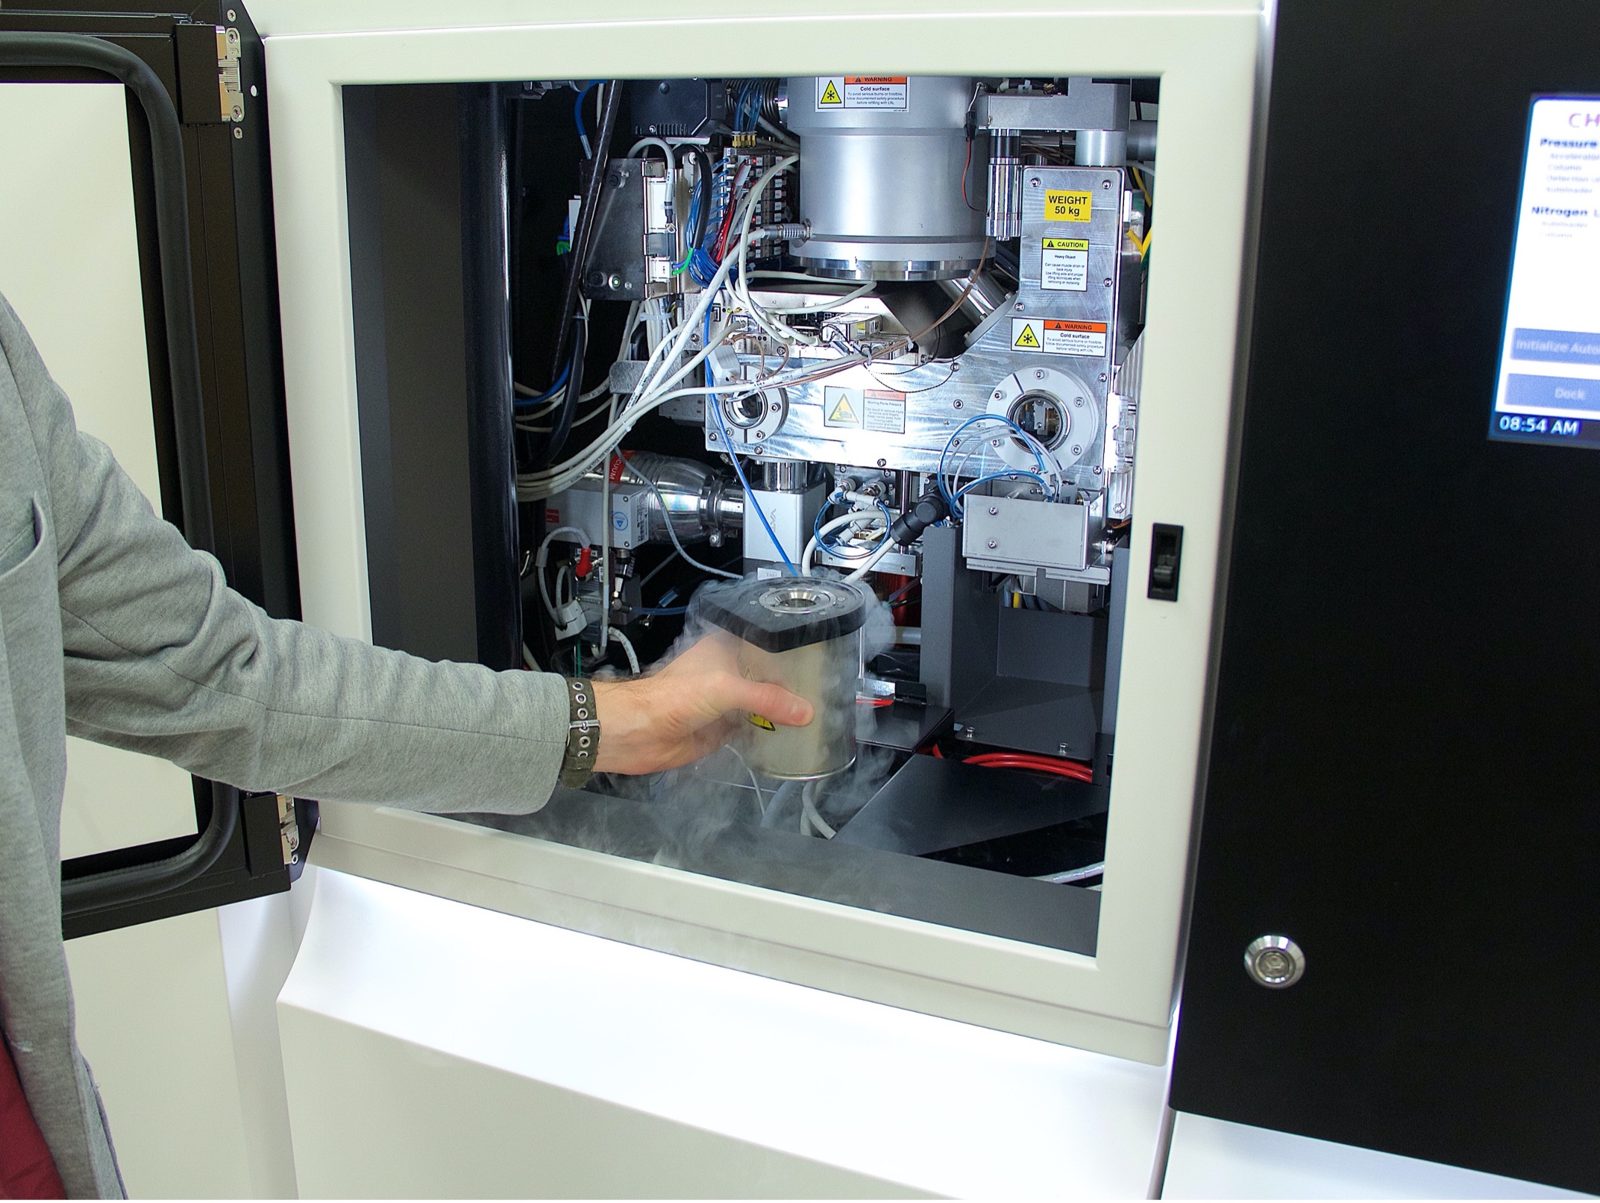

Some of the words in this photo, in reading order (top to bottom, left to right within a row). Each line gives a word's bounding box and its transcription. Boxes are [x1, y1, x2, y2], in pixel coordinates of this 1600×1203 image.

[1540, 138, 1598, 147] Pressure
[1048, 195, 1088, 205] WEIGHT
[1054, 206, 1066, 214] 50
[1068, 206, 1080, 217] kg
[1531, 206, 1588, 218] Nitrogen
[1516, 340, 1569, 353] Initialize
[1554, 387, 1585, 401] Dock
[1499, 415, 1548, 433] 08:54
[1550, 420, 1579, 436] AM
